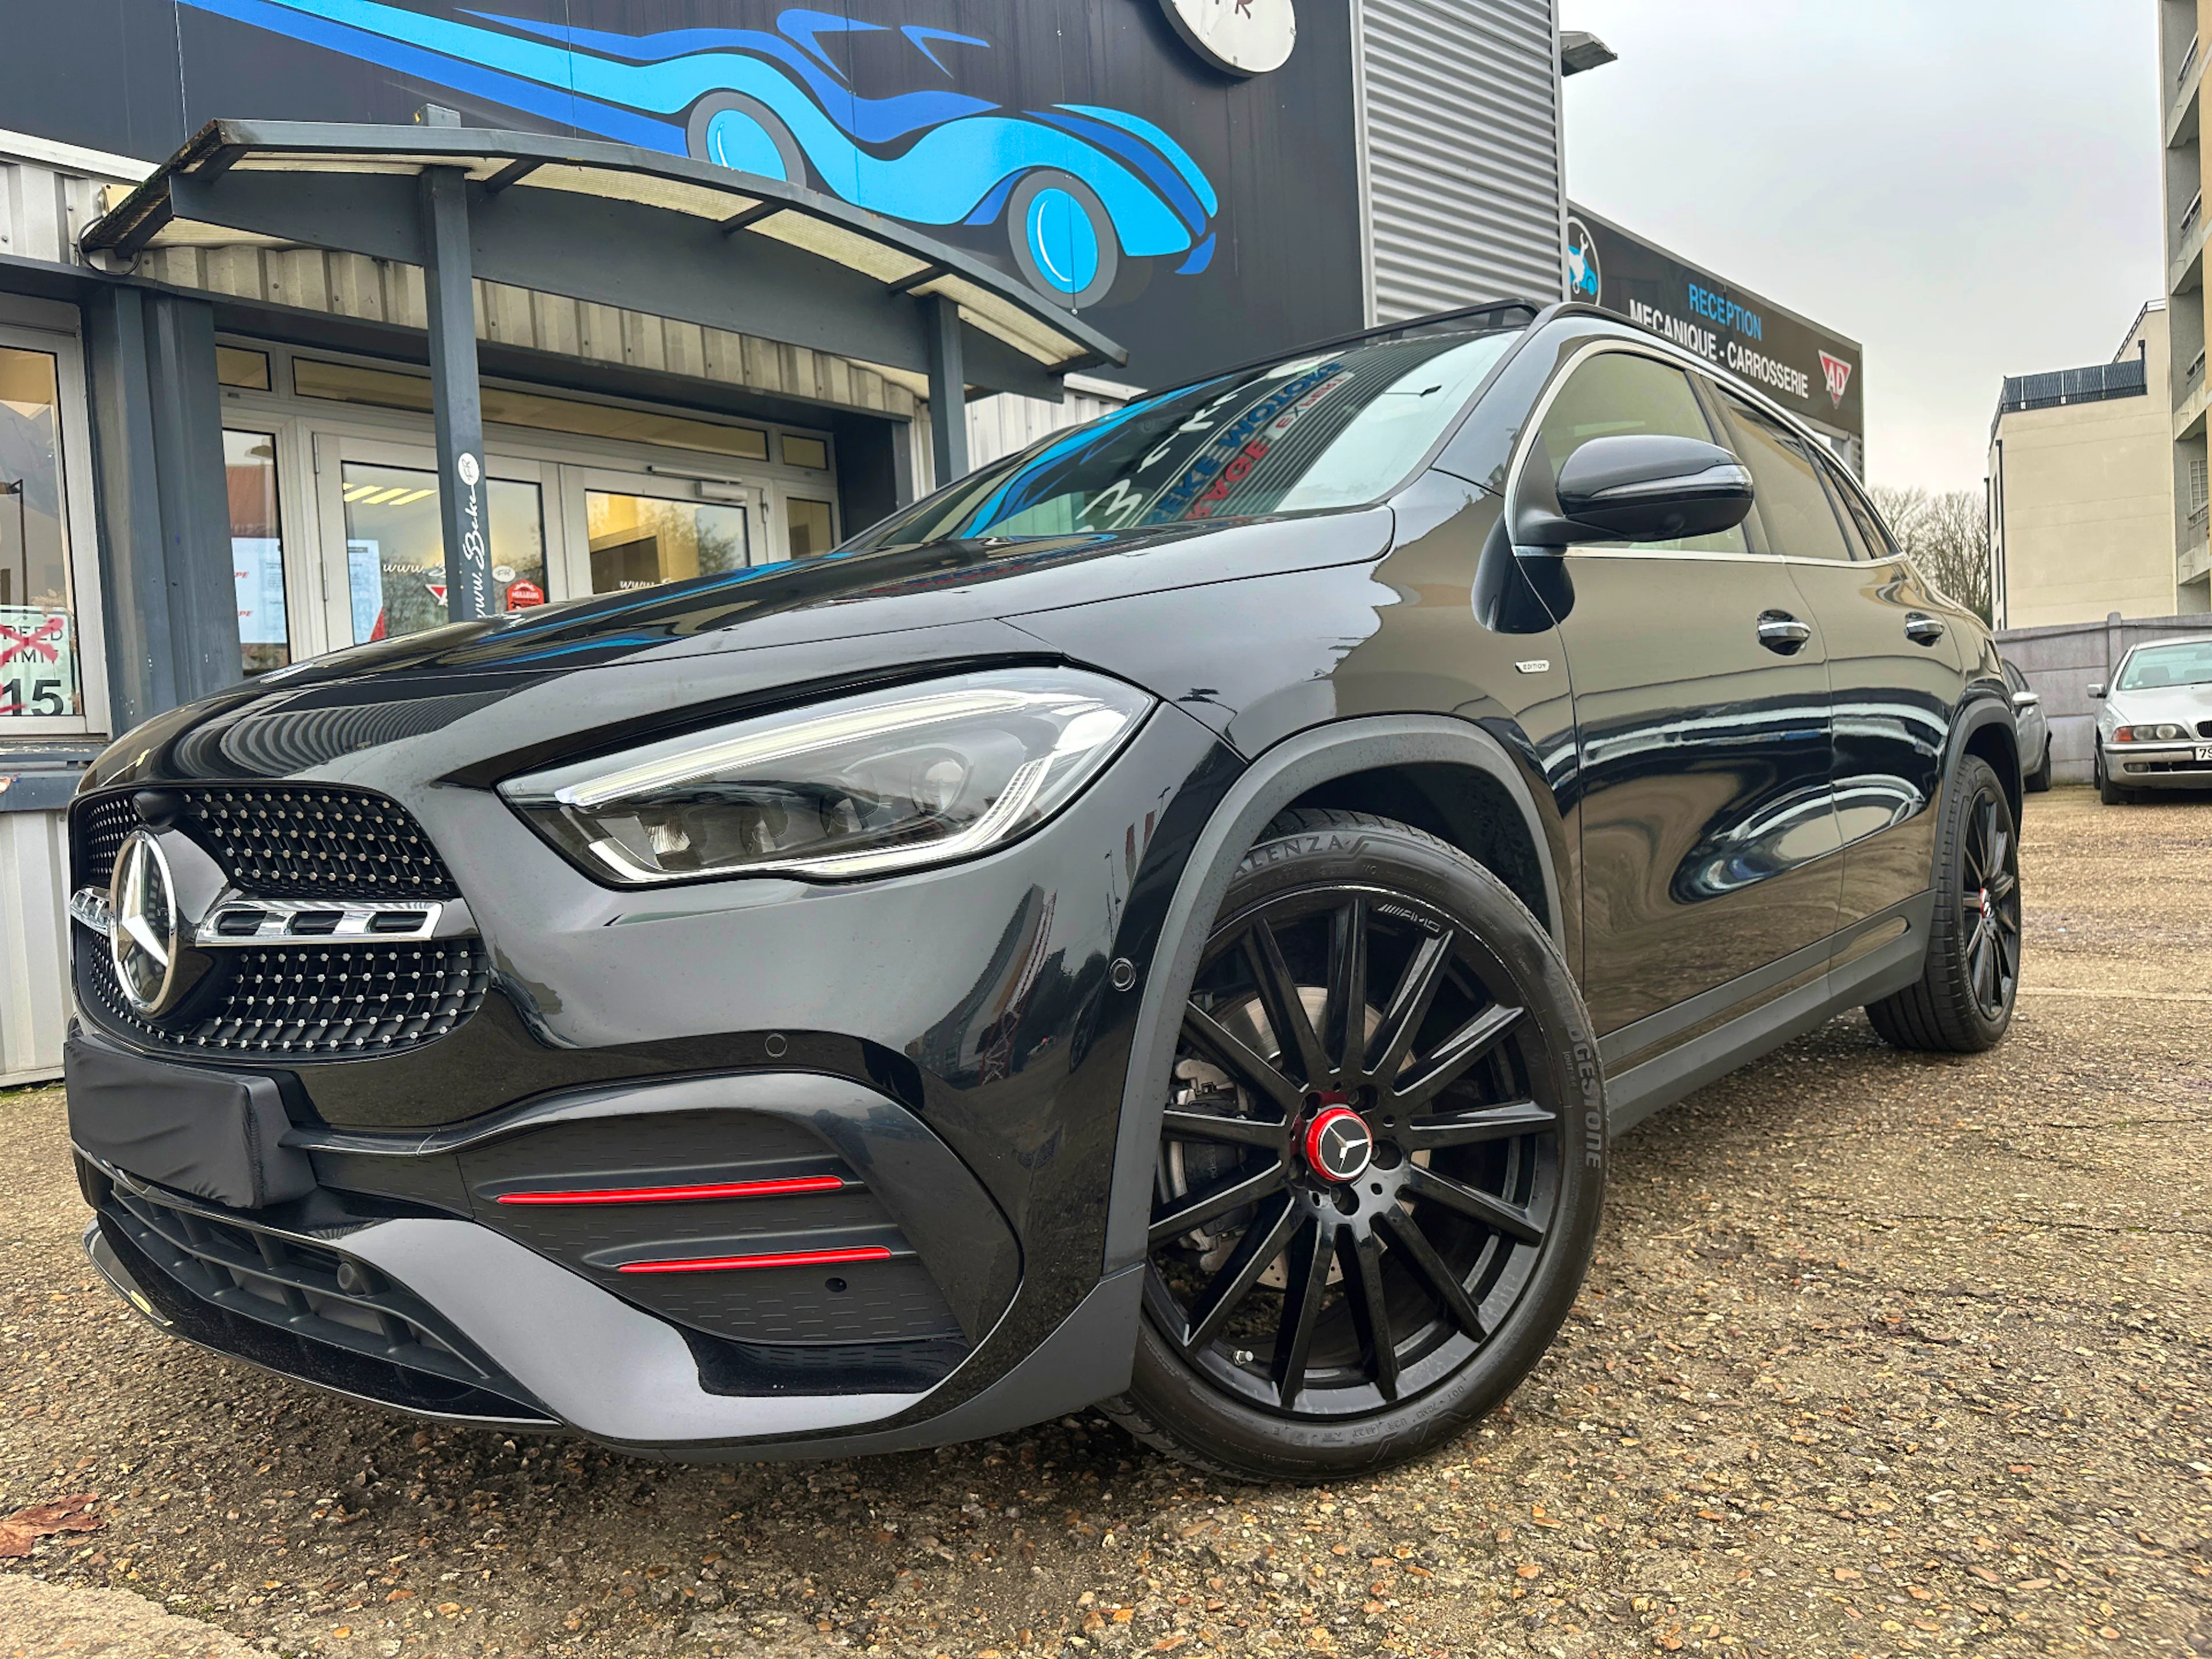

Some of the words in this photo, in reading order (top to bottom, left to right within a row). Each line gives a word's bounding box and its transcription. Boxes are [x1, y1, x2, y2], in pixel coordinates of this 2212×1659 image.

[1688, 283, 1762, 341] RECEPTION
[1630, 299, 1717, 361] MECANIQUE
[1728, 341, 1808, 399] CARROSSERIE
[1826, 362, 1846, 396] AD
[2, 626, 63, 641] PEED
[2, 679, 63, 715] 15
